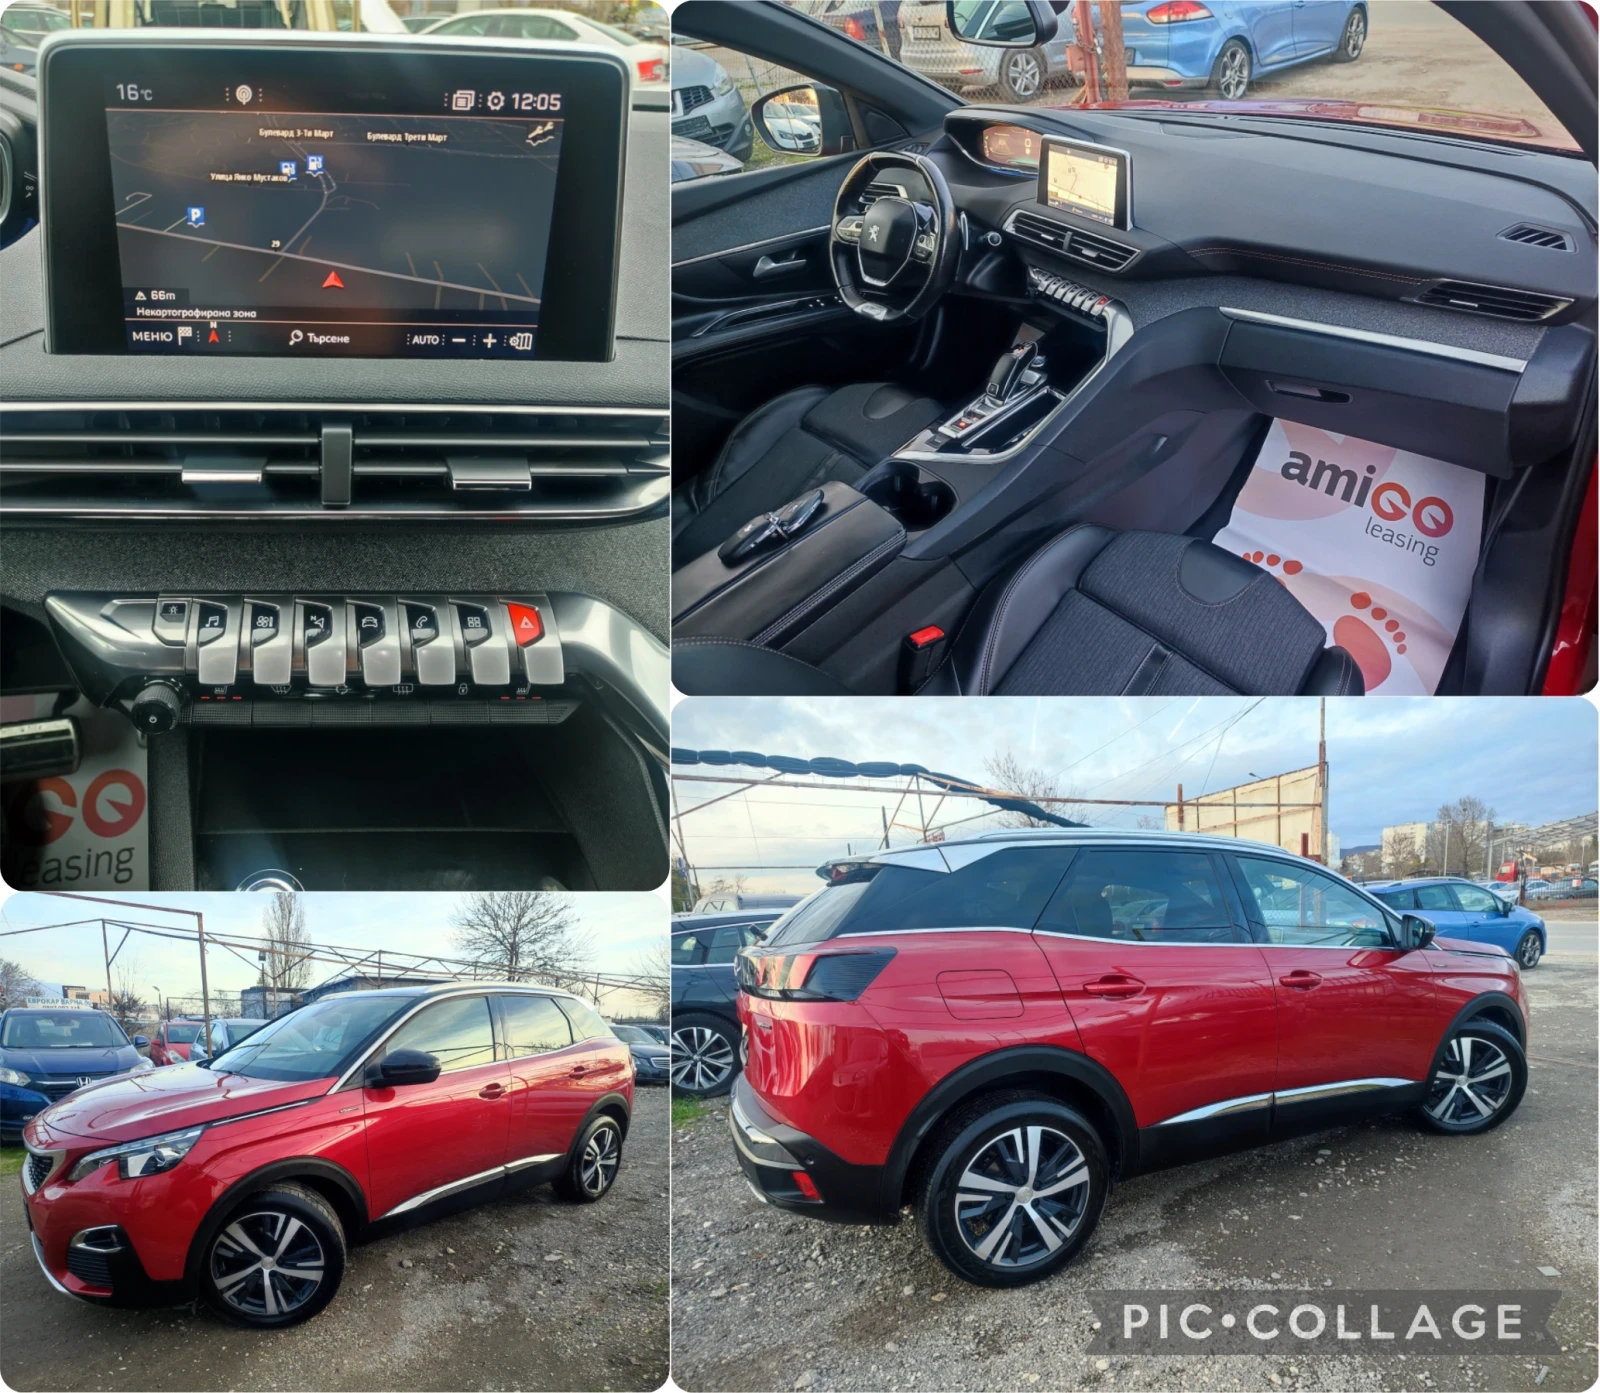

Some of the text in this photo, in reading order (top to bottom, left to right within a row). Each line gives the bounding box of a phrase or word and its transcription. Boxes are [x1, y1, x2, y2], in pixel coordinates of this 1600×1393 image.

[511, 93, 562, 111] 12:05
[259, 128, 294, 138] Булевард
[314, 130, 334, 139] Март
[367, 132, 448, 143] Булевард Трети Март
[210, 173, 232, 182] Улица
[234, 173, 252, 182] Янко
[271, 240, 280, 248] 29
[150, 291, 176, 300] 66m
[136, 307, 257, 319] Некартографирана зона
[132, 331, 173, 342] МЕНЮ
[307, 333, 350, 344] Търсене
[412, 335, 440, 345] AUTO
[1281, 451, 1454, 538] amiGO
[1365, 516, 1440, 566] leasing
[18, 847, 135, 886] easing
